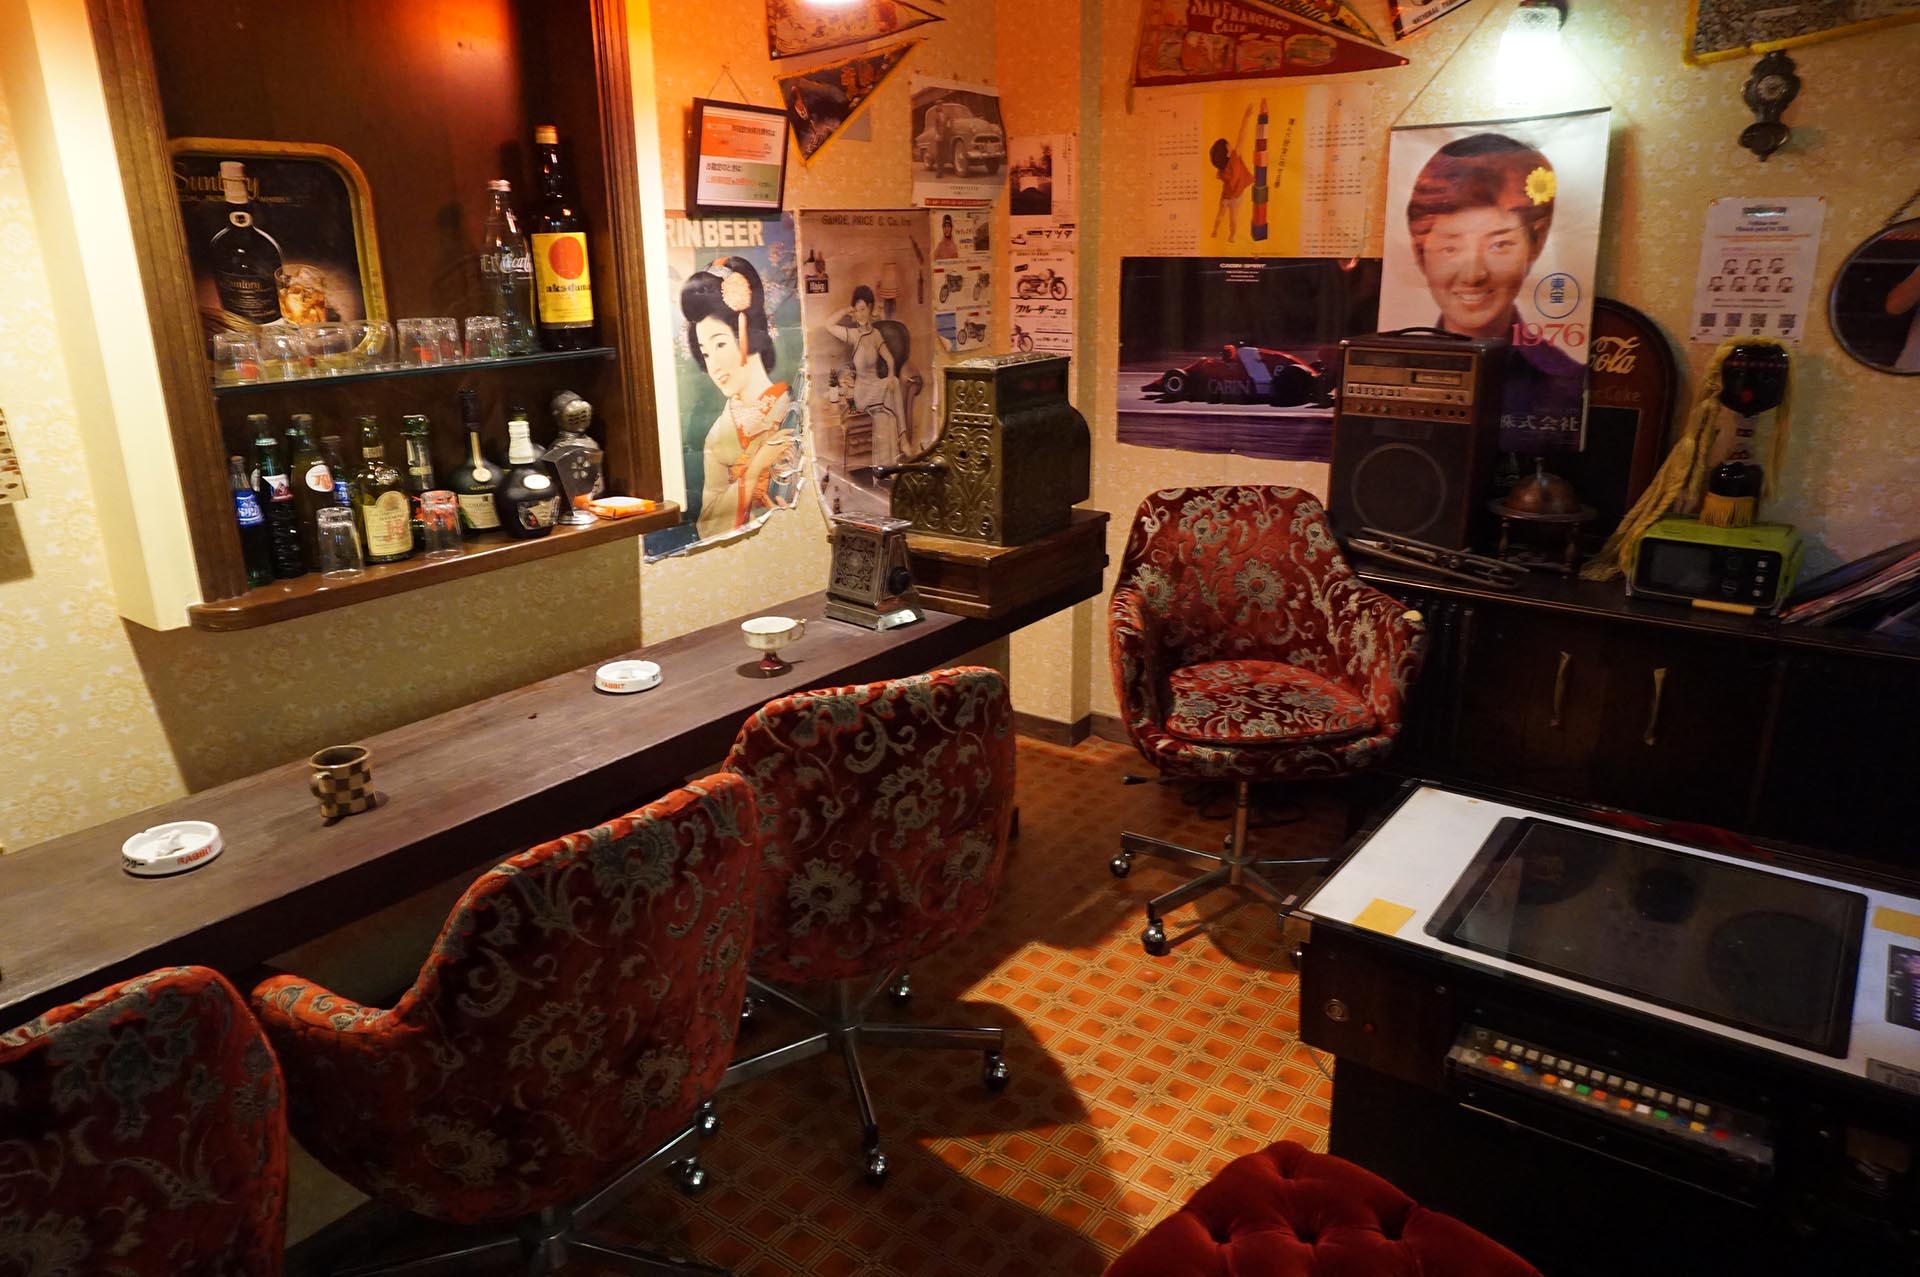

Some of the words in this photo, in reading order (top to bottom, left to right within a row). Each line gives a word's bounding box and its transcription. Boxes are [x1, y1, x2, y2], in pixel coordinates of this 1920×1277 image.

[1222, 1, 1290, 31] FRANCISCO
[665, 218, 702, 247] RIN
[704, 219, 765, 247] BEER
[1511, 322, 1585, 347] 1976
[1207, 376, 1250, 395] CABIN
[1500, 414, 1580, 432] 株式会社
[176, 844, 213, 865] RABBIT
